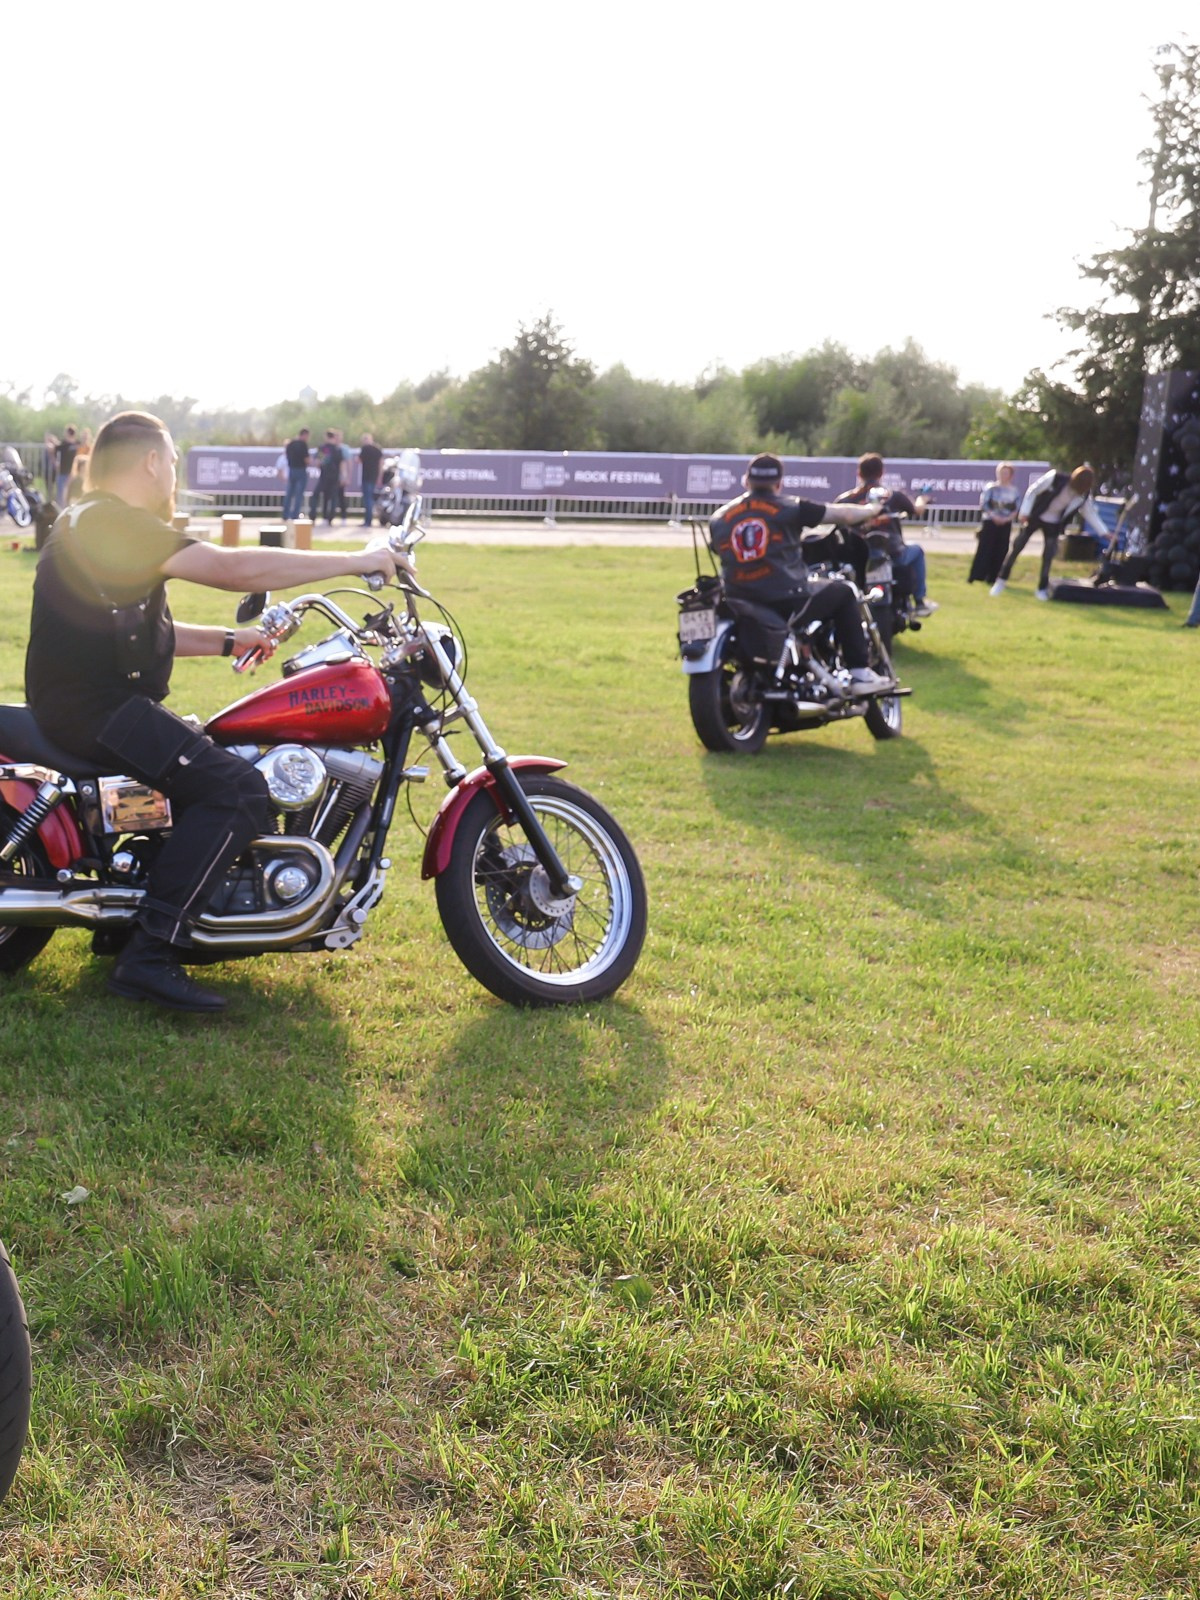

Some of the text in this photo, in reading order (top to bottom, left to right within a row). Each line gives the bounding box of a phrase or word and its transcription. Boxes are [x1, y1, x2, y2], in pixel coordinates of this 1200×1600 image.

[418, 467, 498, 481] OCK FESTIVAL
[574, 470, 608, 483] ROCK
[609, 471, 663, 485] FESTIVAL
[783, 475, 831, 489] ESTIVAL
[947, 479, 988, 492] FESTIV
[289, 686, 356, 708] HARLEY-
[305, 698, 369, 715] DAVIDSON
